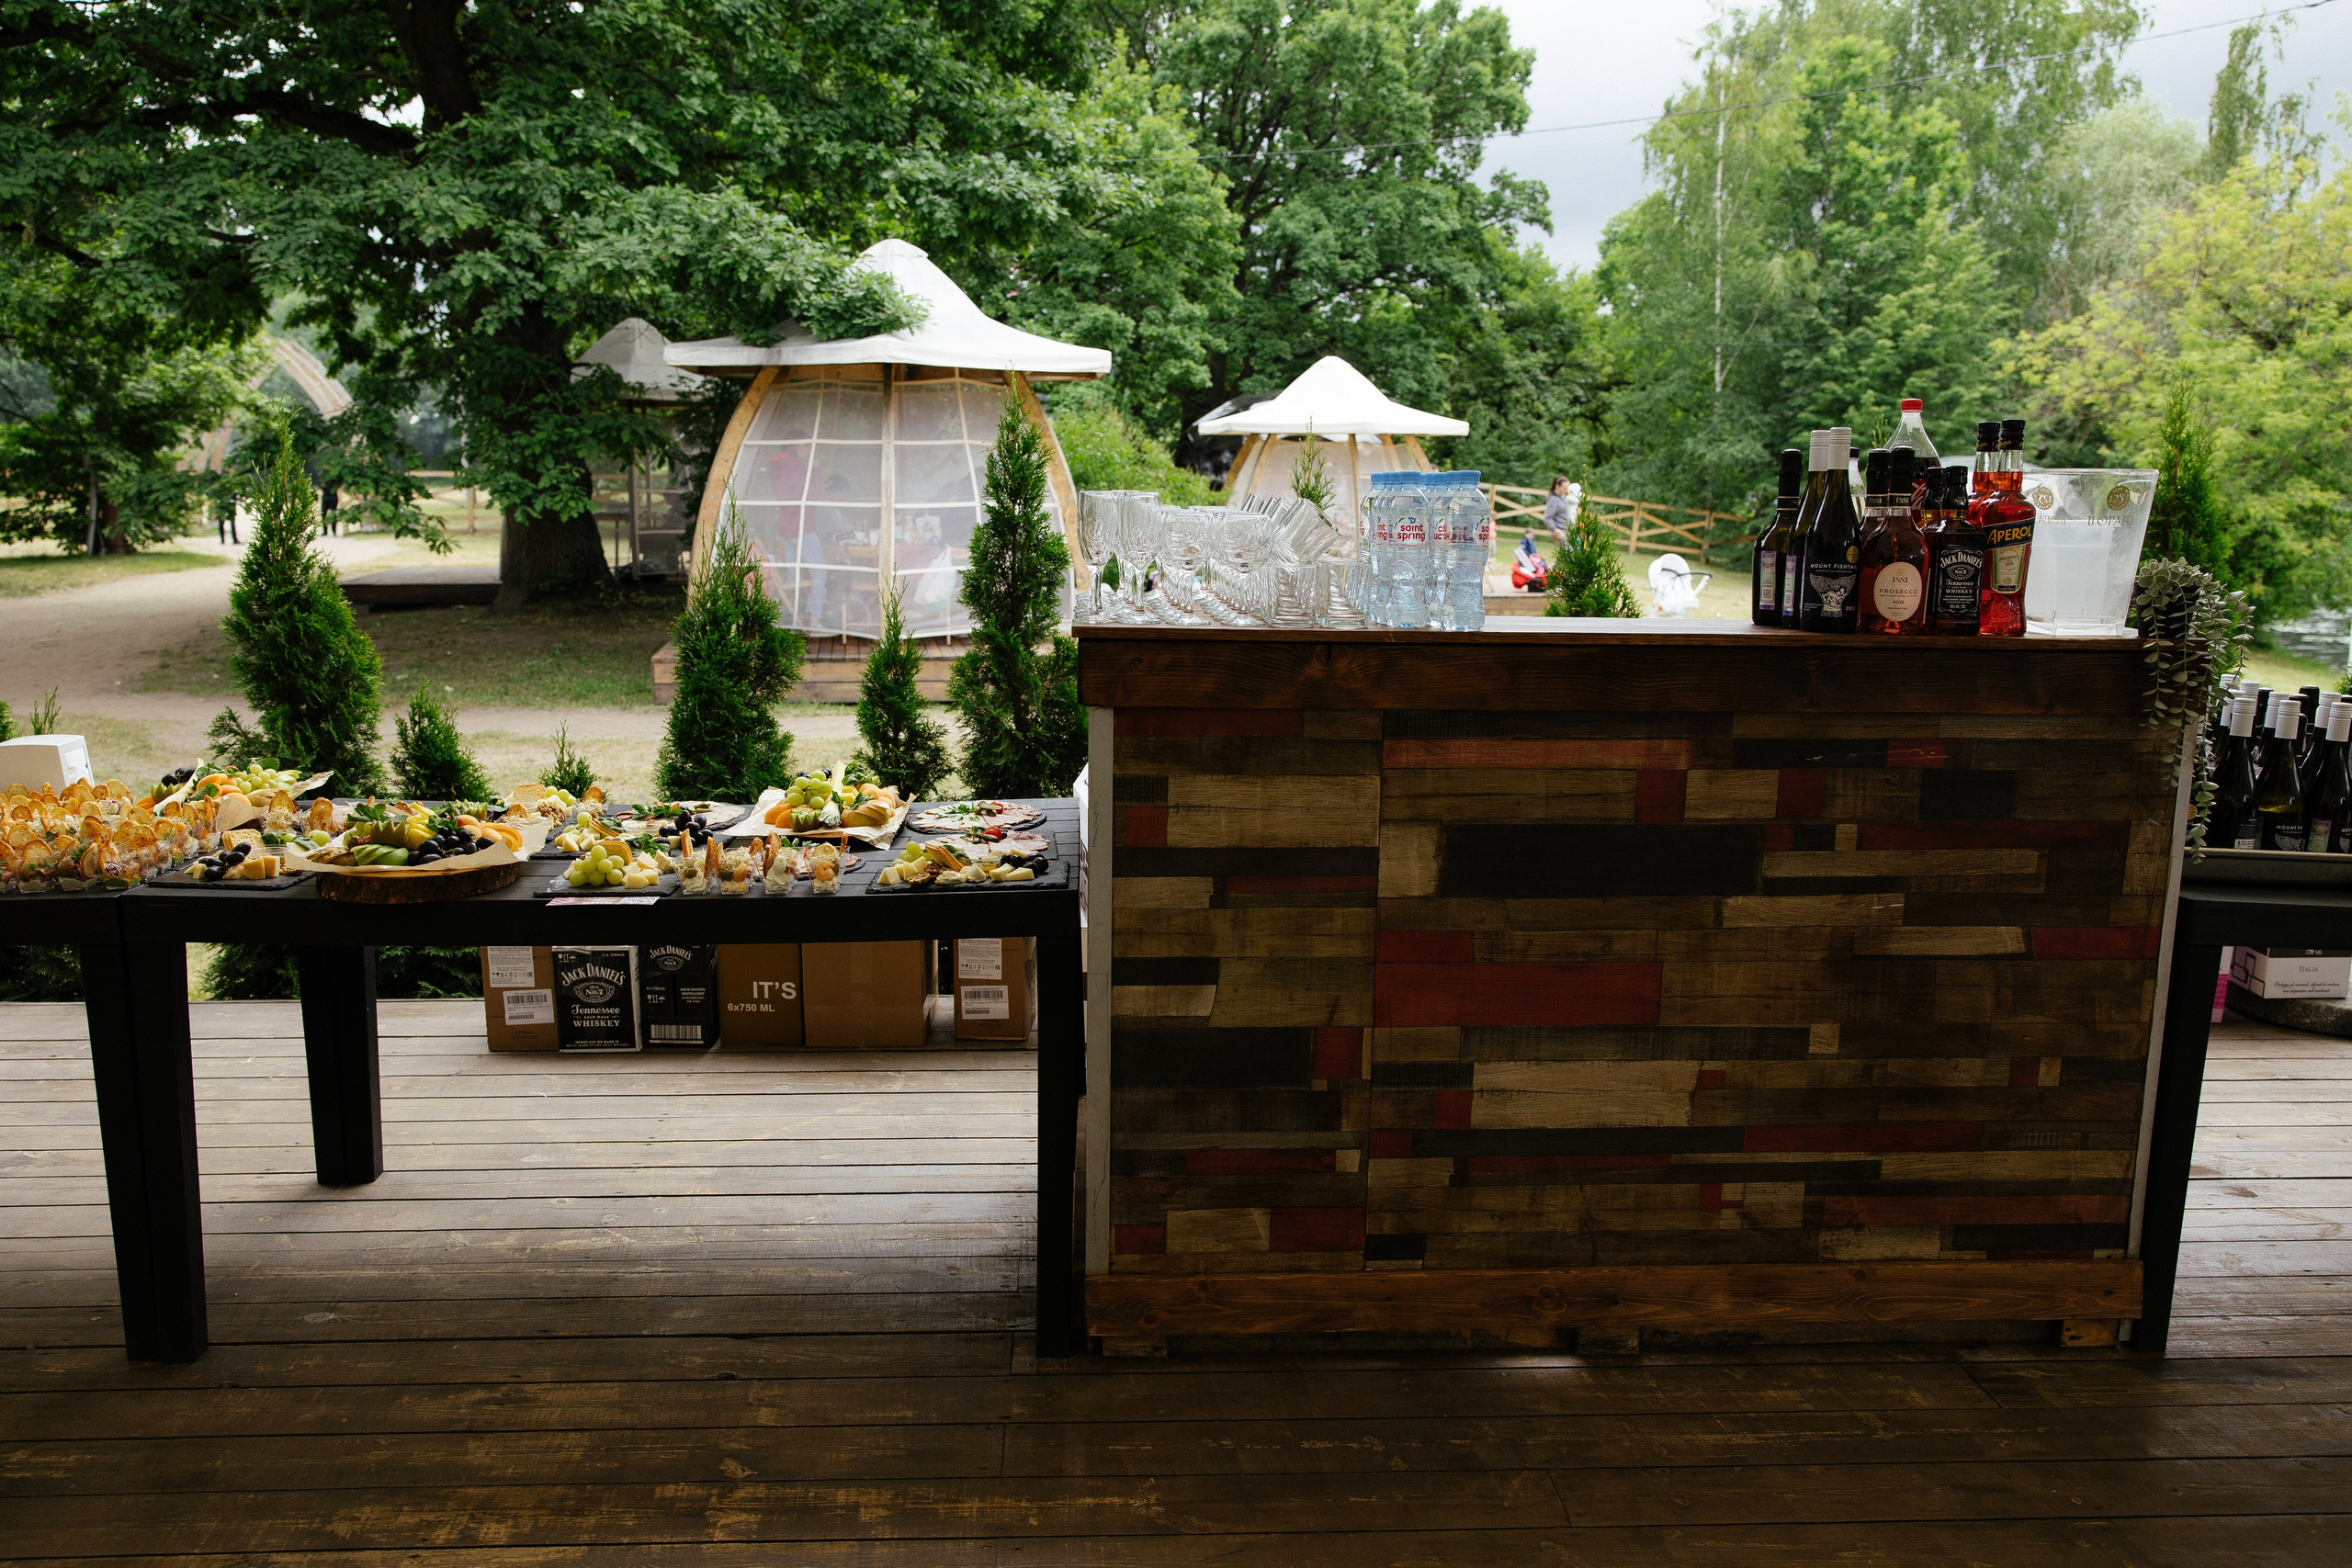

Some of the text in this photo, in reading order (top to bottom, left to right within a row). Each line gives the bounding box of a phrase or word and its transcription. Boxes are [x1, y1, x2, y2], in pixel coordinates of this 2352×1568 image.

[2109, 494, 2124, 505] 125
[1400, 524, 1423, 532] saint
[1397, 532, 1426, 542] spring
[1987, 525, 2031, 545] APEROL
[1939, 551, 1984, 569] JACK DANIEL'S
[650, 945, 693, 961] JACK DANIEL'S
[561, 963, 626, 986] JACK DANIEL'S
[752, 981, 797, 1000] IT'S
[571, 1004, 620, 1015] Tennessee
[728, 1003, 775, 1012] 6x750 ML
